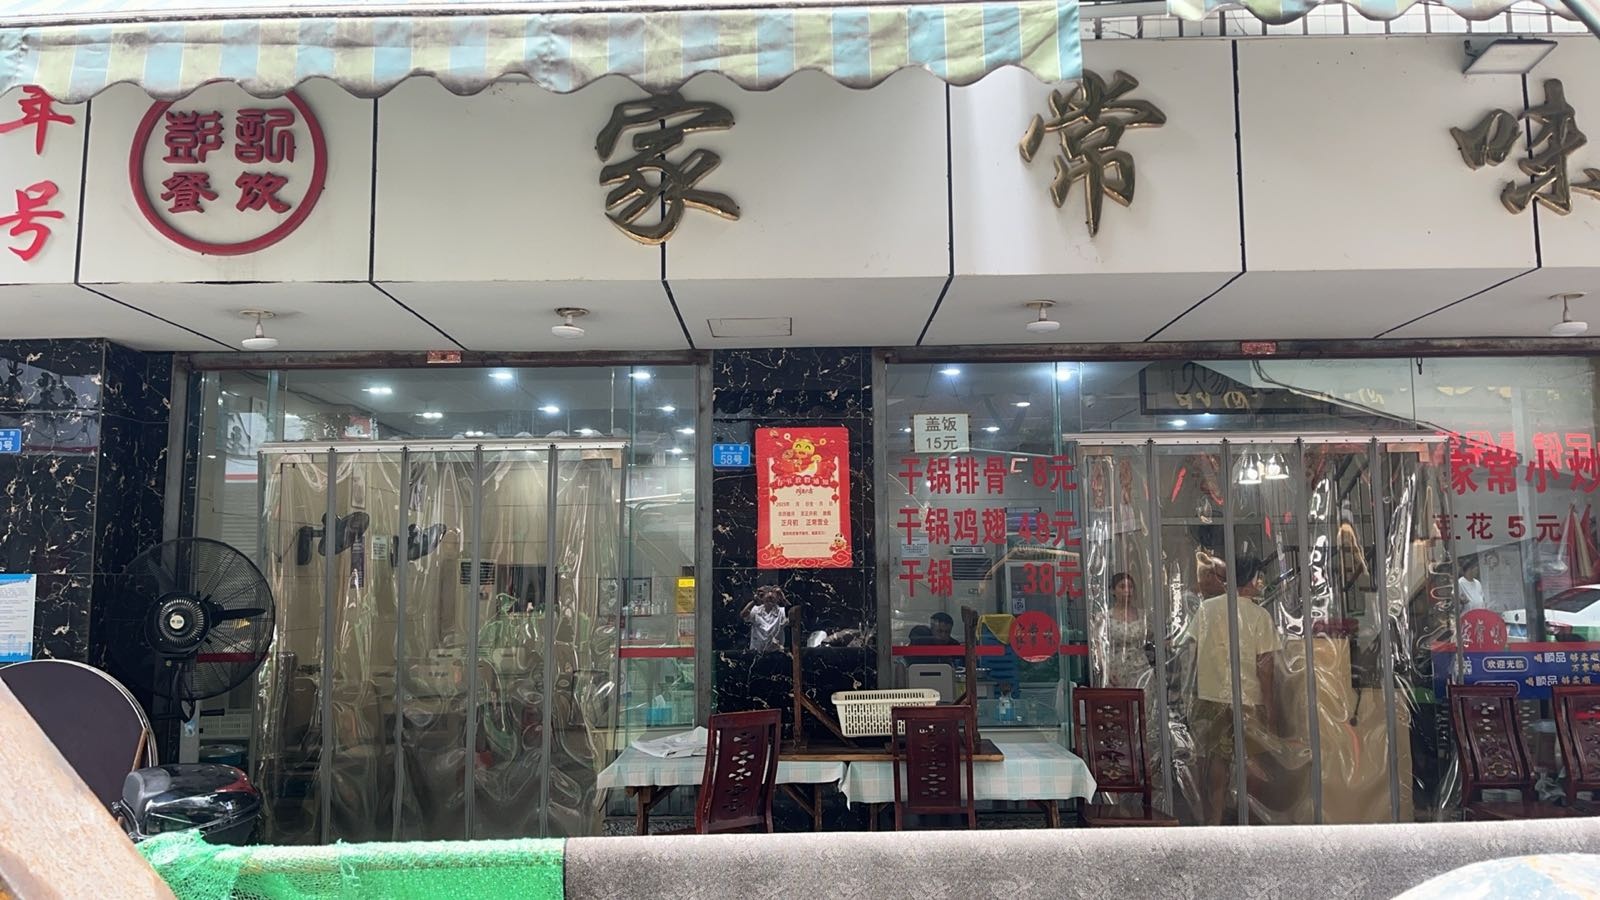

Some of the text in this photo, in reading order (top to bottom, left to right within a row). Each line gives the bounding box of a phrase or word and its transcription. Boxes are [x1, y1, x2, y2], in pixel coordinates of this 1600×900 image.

[161, 171, 292, 214] 餐饮
[925, 416, 957, 432] 盖饭
[926, 435, 958, 450] 15元
[720, 454, 743, 465] 58号
[898, 456, 1008, 494] 干锅排骨
[1450, 448, 1600, 494] 家常小炒
[897, 508, 1081, 546] 干锅鸡翅 48元
[1508, 514, 1563, 542] 5元
[899, 558, 1083, 598] 干锅 38元
[1487, 659, 1525, 670] 欢迎光临
